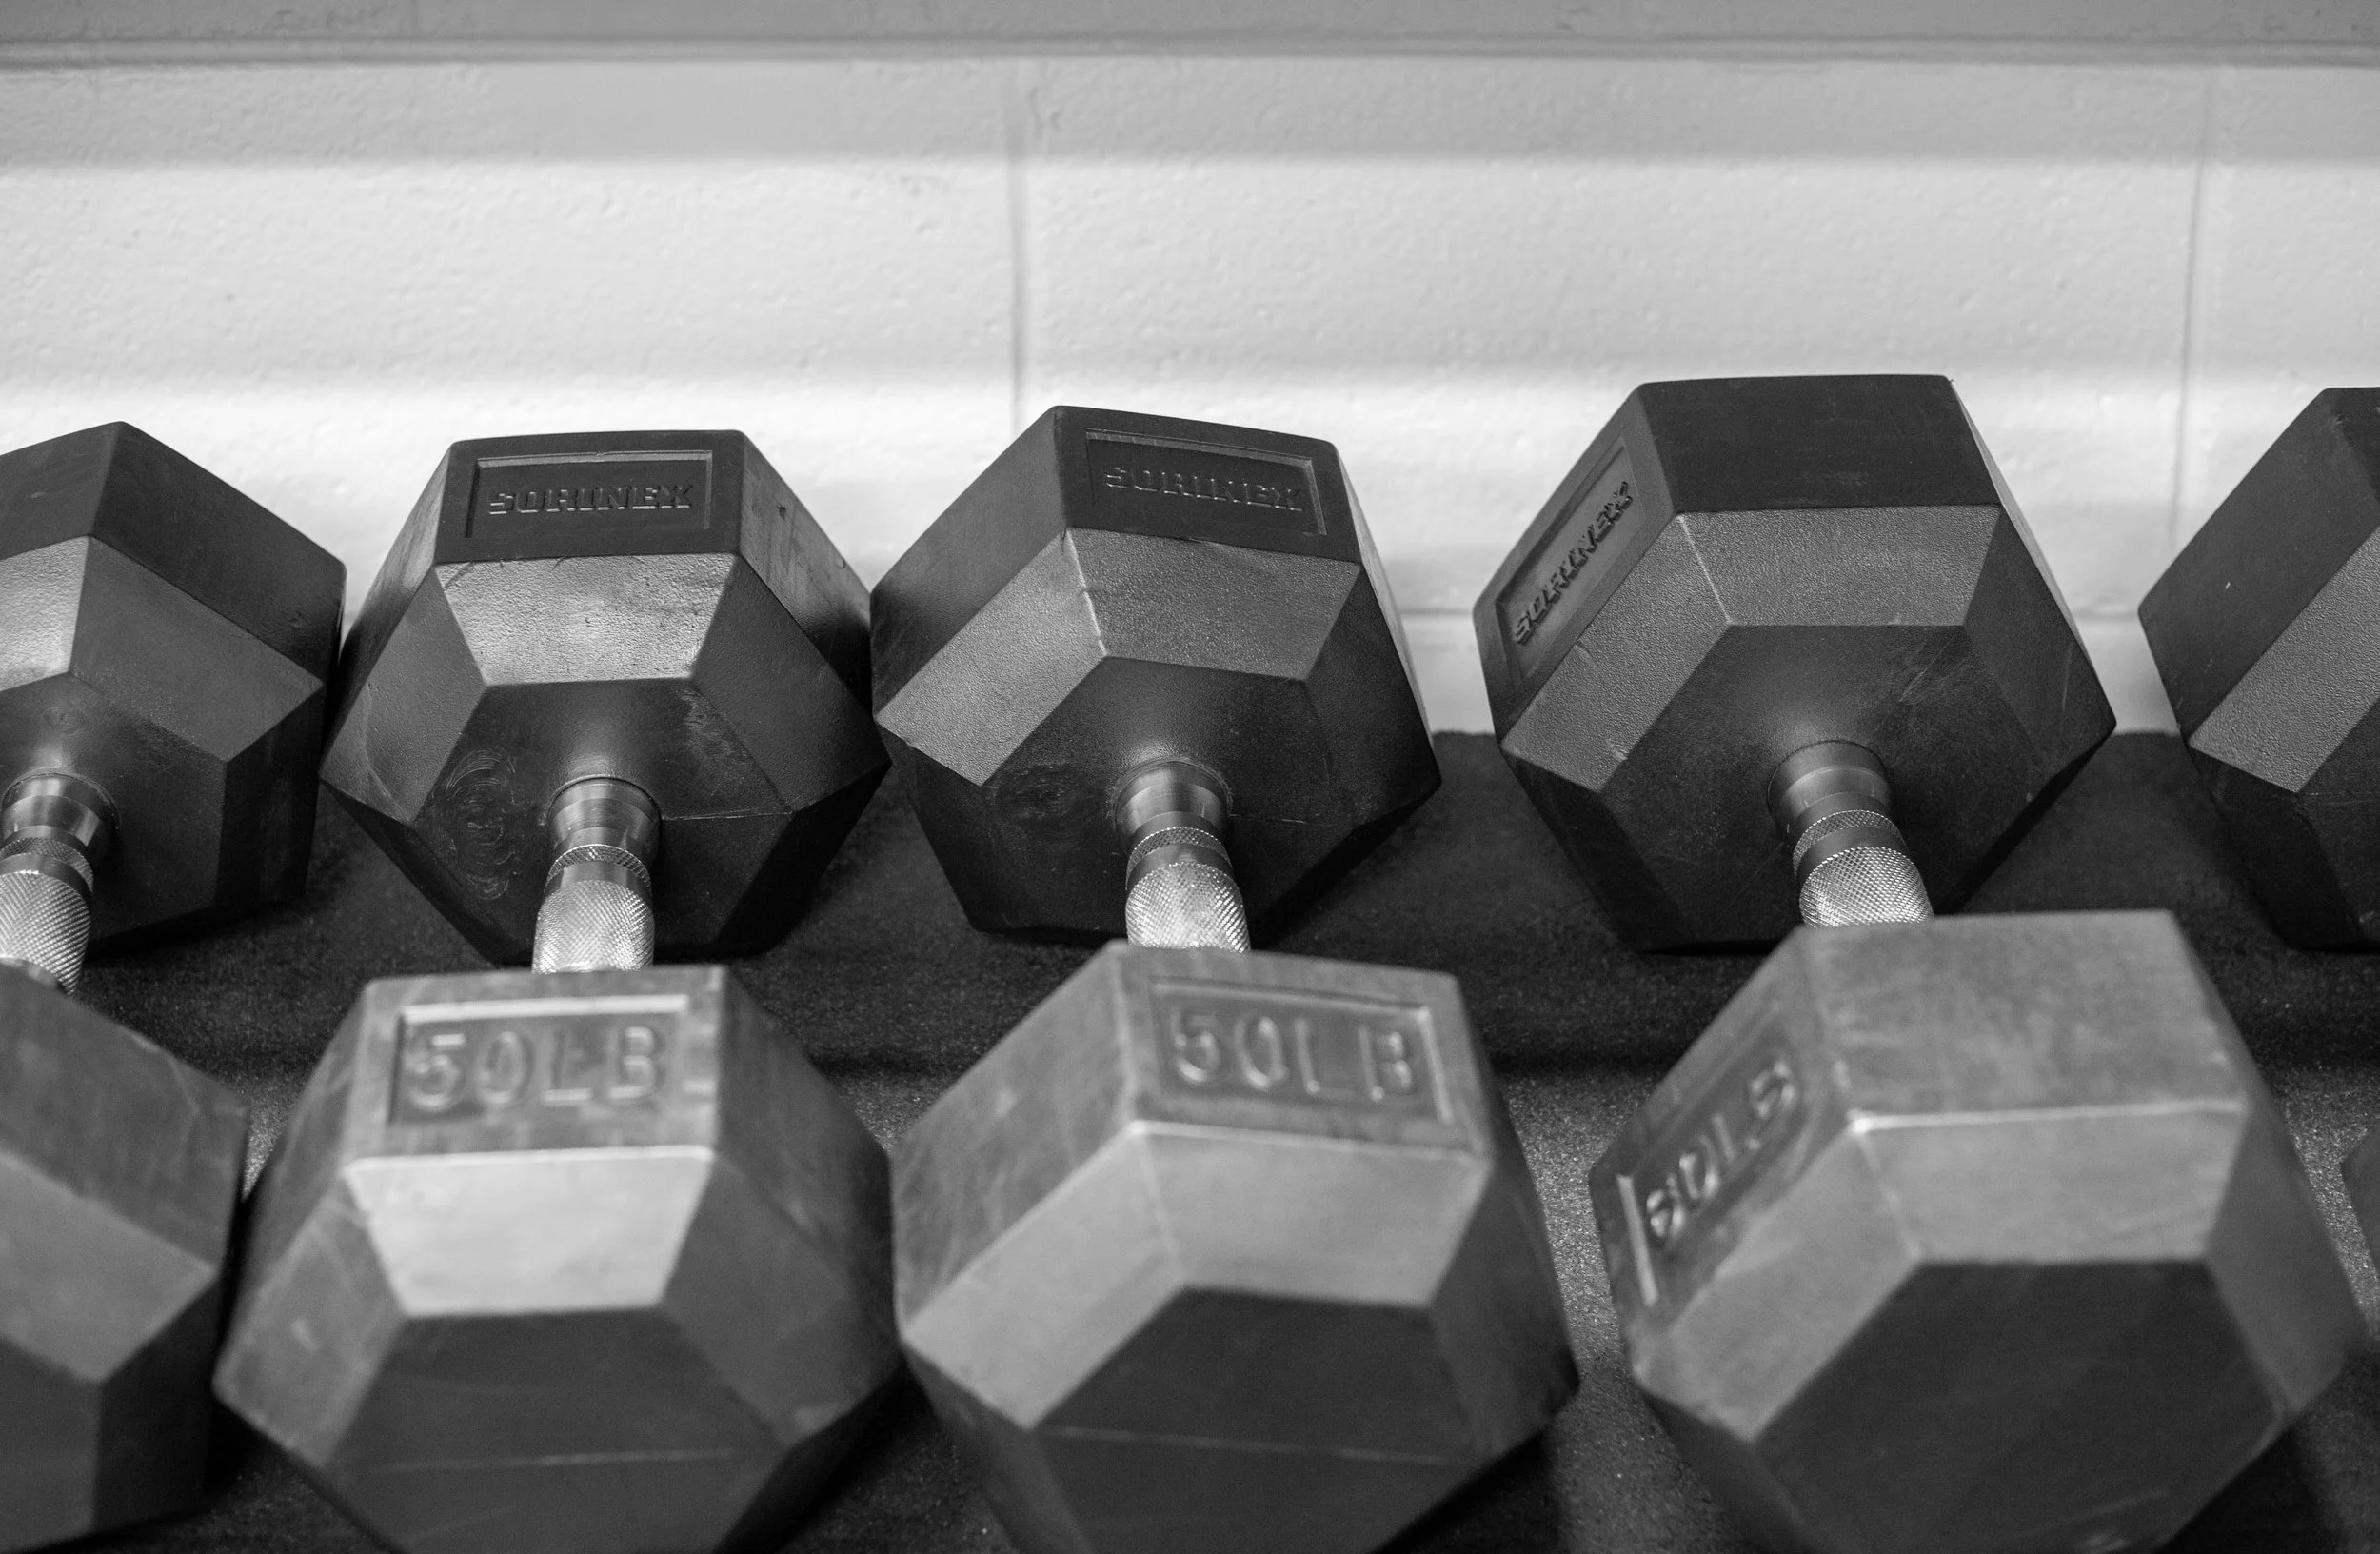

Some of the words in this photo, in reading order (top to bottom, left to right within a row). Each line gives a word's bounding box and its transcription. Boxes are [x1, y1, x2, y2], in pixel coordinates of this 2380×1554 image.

[488, 484, 694, 516] SORINEX
[1103, 465, 1303, 513] SORINEX
[1511, 480, 1634, 646] SORINEX
[405, 1026, 663, 1113] 50LB
[1169, 1006, 1416, 1101] 50LB
